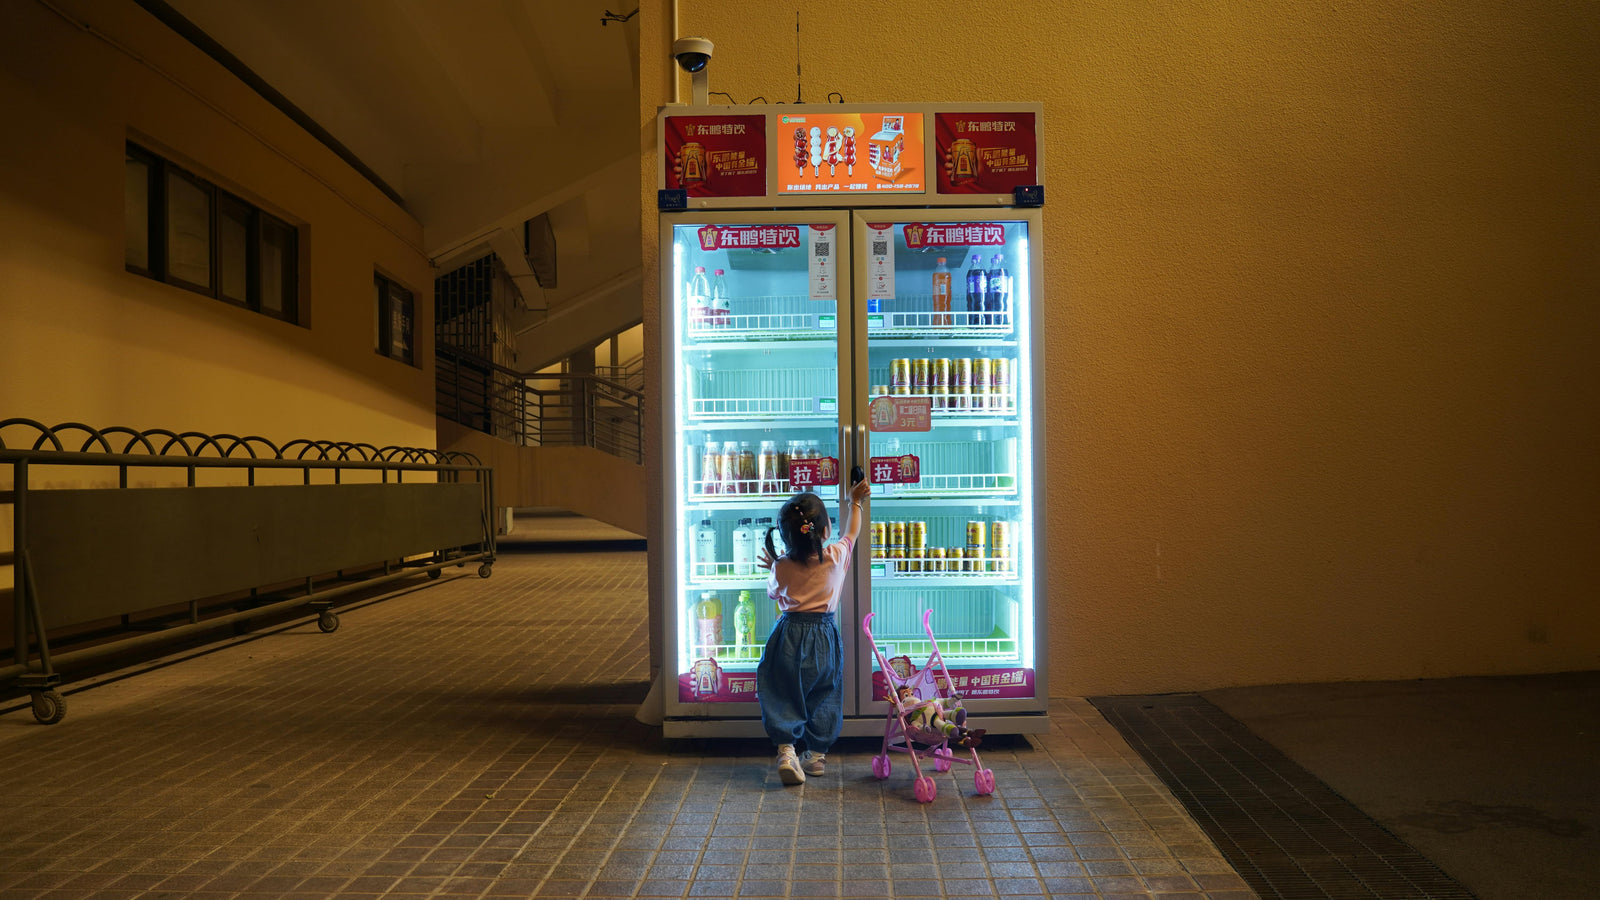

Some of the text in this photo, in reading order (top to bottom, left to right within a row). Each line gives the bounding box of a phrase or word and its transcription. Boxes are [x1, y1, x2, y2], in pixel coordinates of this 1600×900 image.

[697, 124, 746, 135] 东鹏特饮
[968, 121, 1016, 132] 东鹏特饮
[721, 229, 797, 246] 东鹏特饮
[926, 227, 1003, 243] 东鹏特饮
[900, 417, 916, 427] 3元
[794, 466, 812, 484] 拉
[874, 464, 893, 482] 拉
[730, 680, 758, 693] 东鹏
[971, 670, 1024, 687] 中国有金罐
